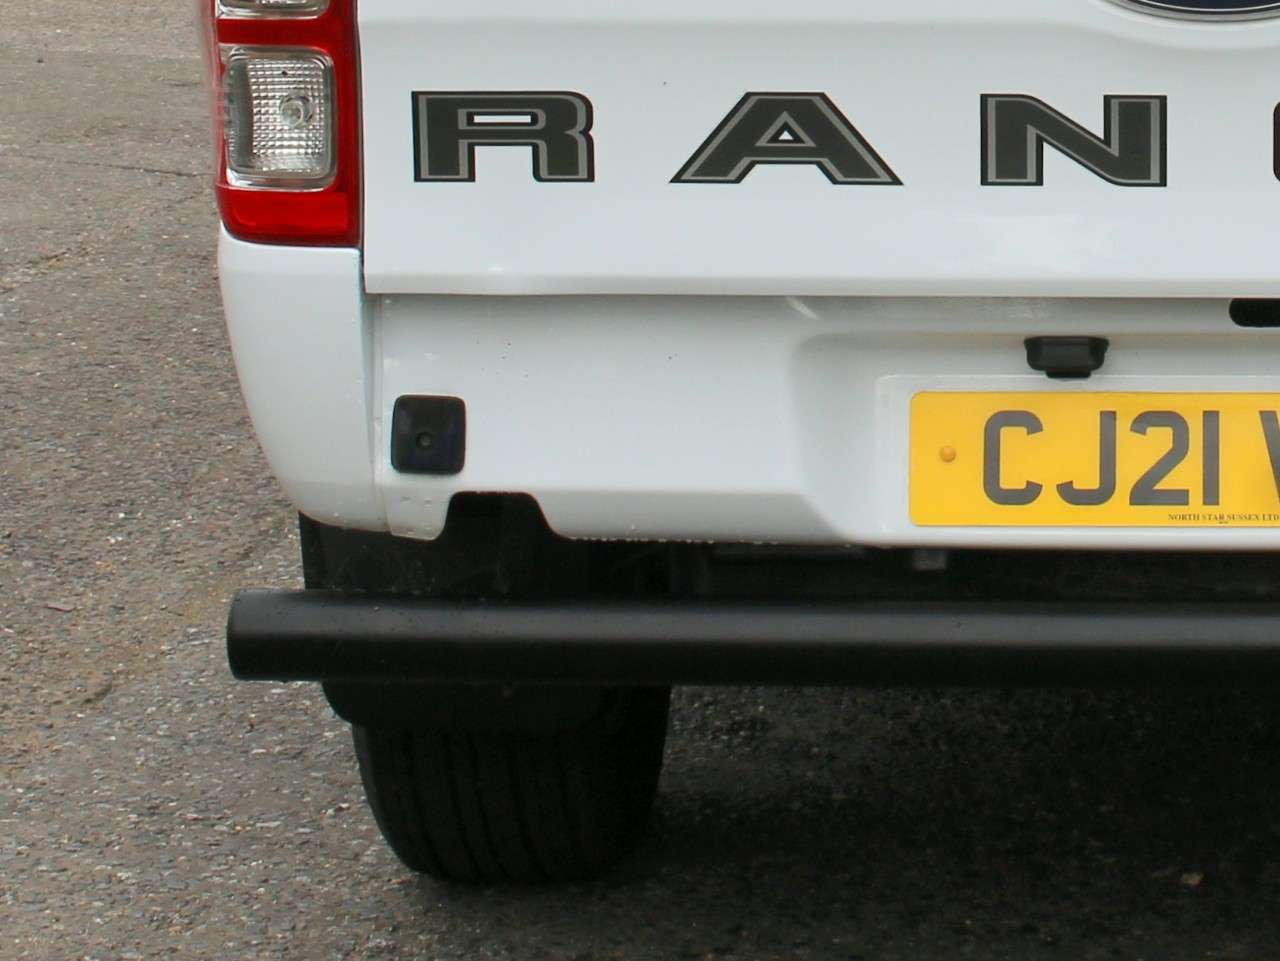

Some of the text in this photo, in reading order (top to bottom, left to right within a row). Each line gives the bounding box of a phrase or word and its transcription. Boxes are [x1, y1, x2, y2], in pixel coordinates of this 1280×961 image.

[982, 410, 1220, 506] CJ21
[1168, 513, 1280, 521] NORTH STAR SUSSEX LTD
